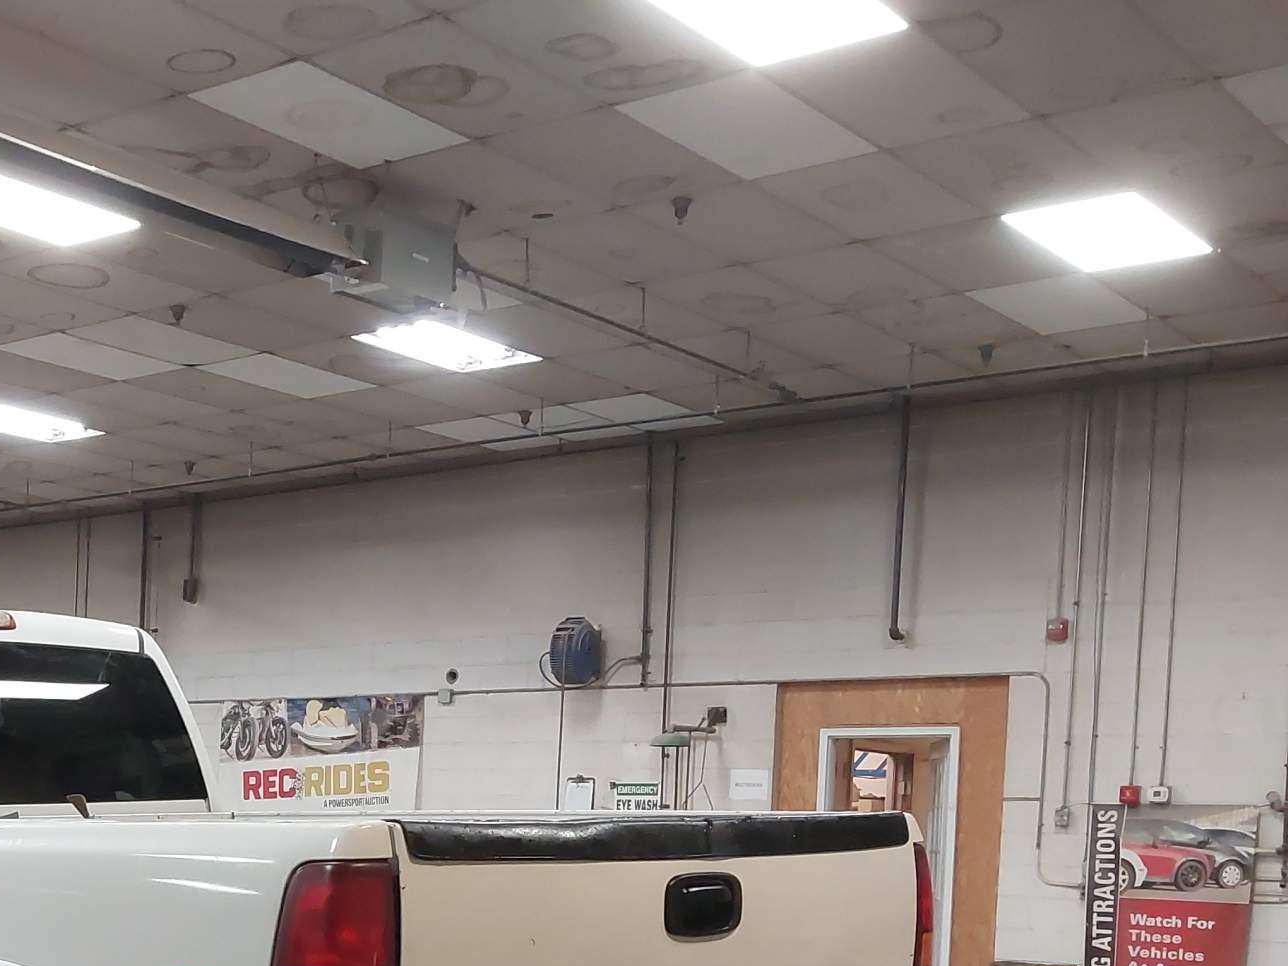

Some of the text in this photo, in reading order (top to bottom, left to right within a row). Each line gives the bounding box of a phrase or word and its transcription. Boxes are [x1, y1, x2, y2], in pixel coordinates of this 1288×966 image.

[242, 760, 392, 801] REC RIDES
[617, 785, 658, 795] EMERGENCY
[616, 799, 658, 810] EYE WASH
[1091, 809, 1119, 952] ATTRACTIONS
[1129, 913, 1216, 930] Watch For
[1128, 929, 1182, 944] These
[1127, 945, 1205, 962] Vehicles
